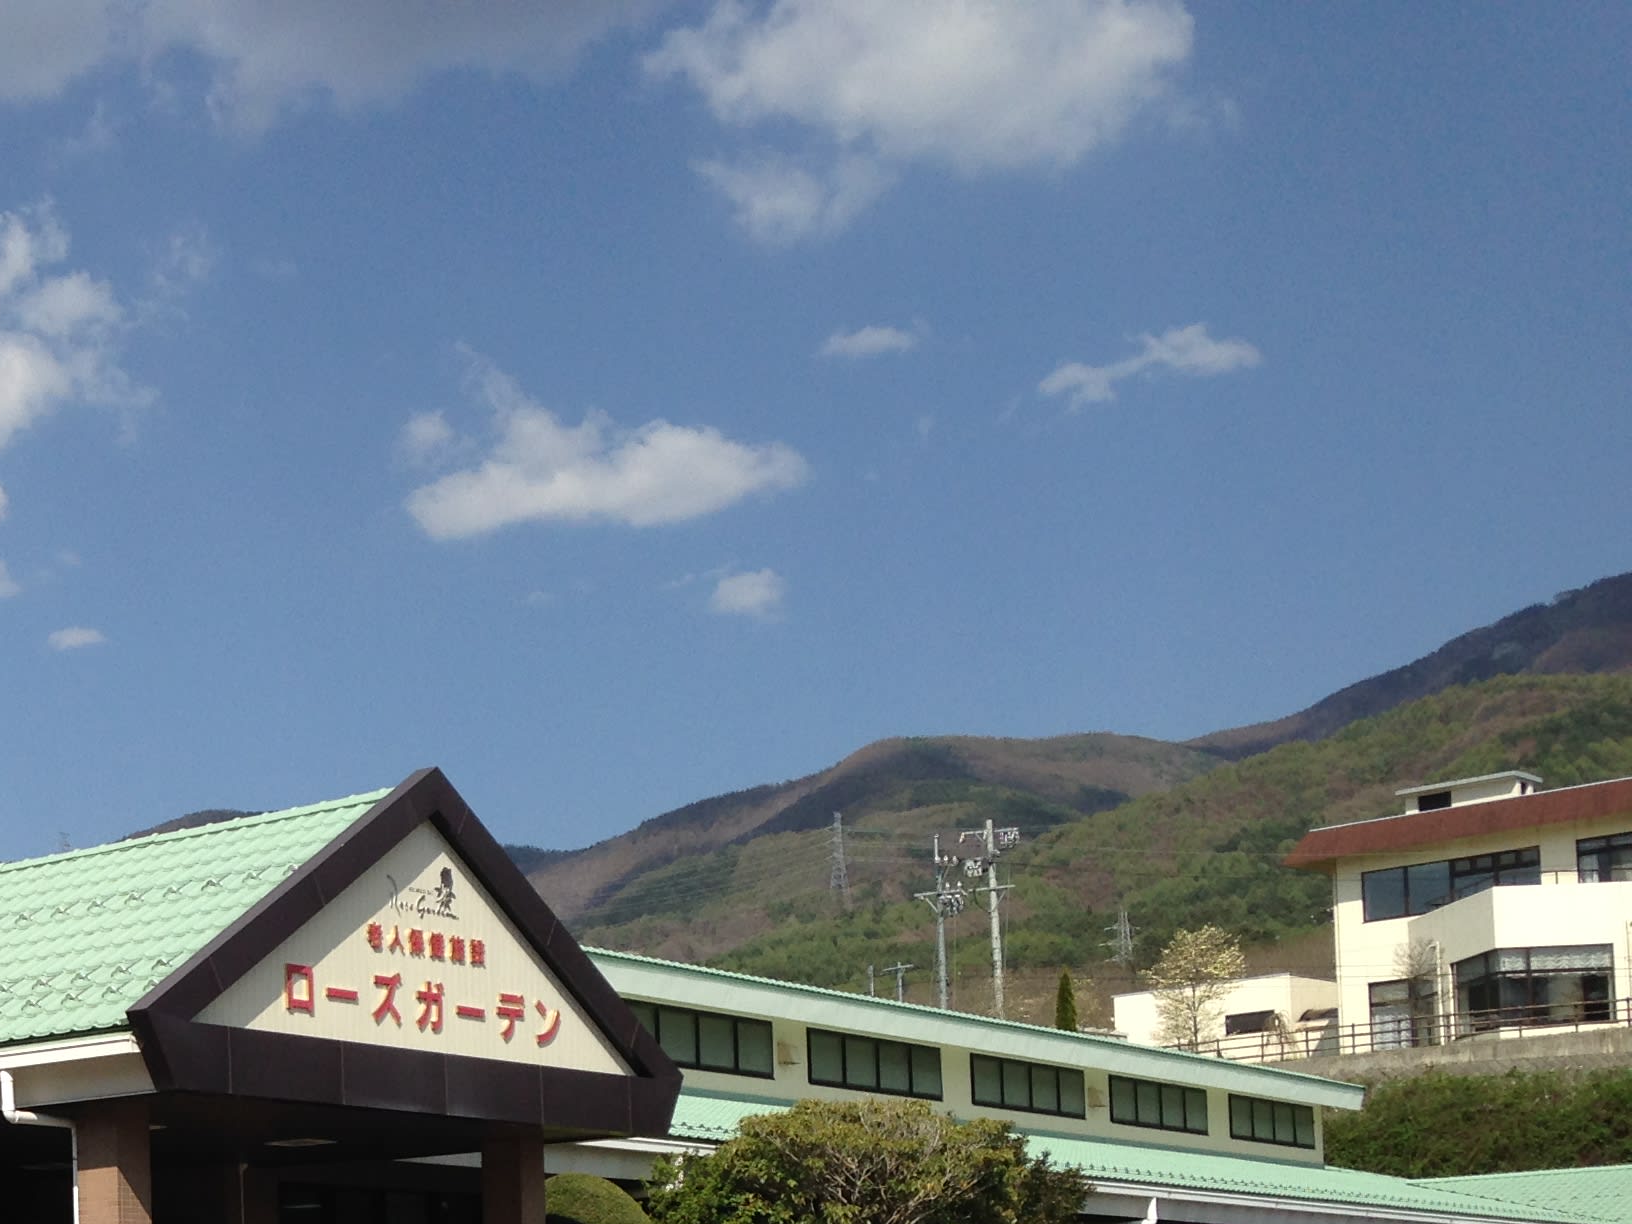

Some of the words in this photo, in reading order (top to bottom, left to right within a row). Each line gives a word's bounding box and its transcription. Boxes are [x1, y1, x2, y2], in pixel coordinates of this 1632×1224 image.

[367, 922, 486, 967] 老人保健施設
[285, 963, 561, 1047] ローズガーデン
